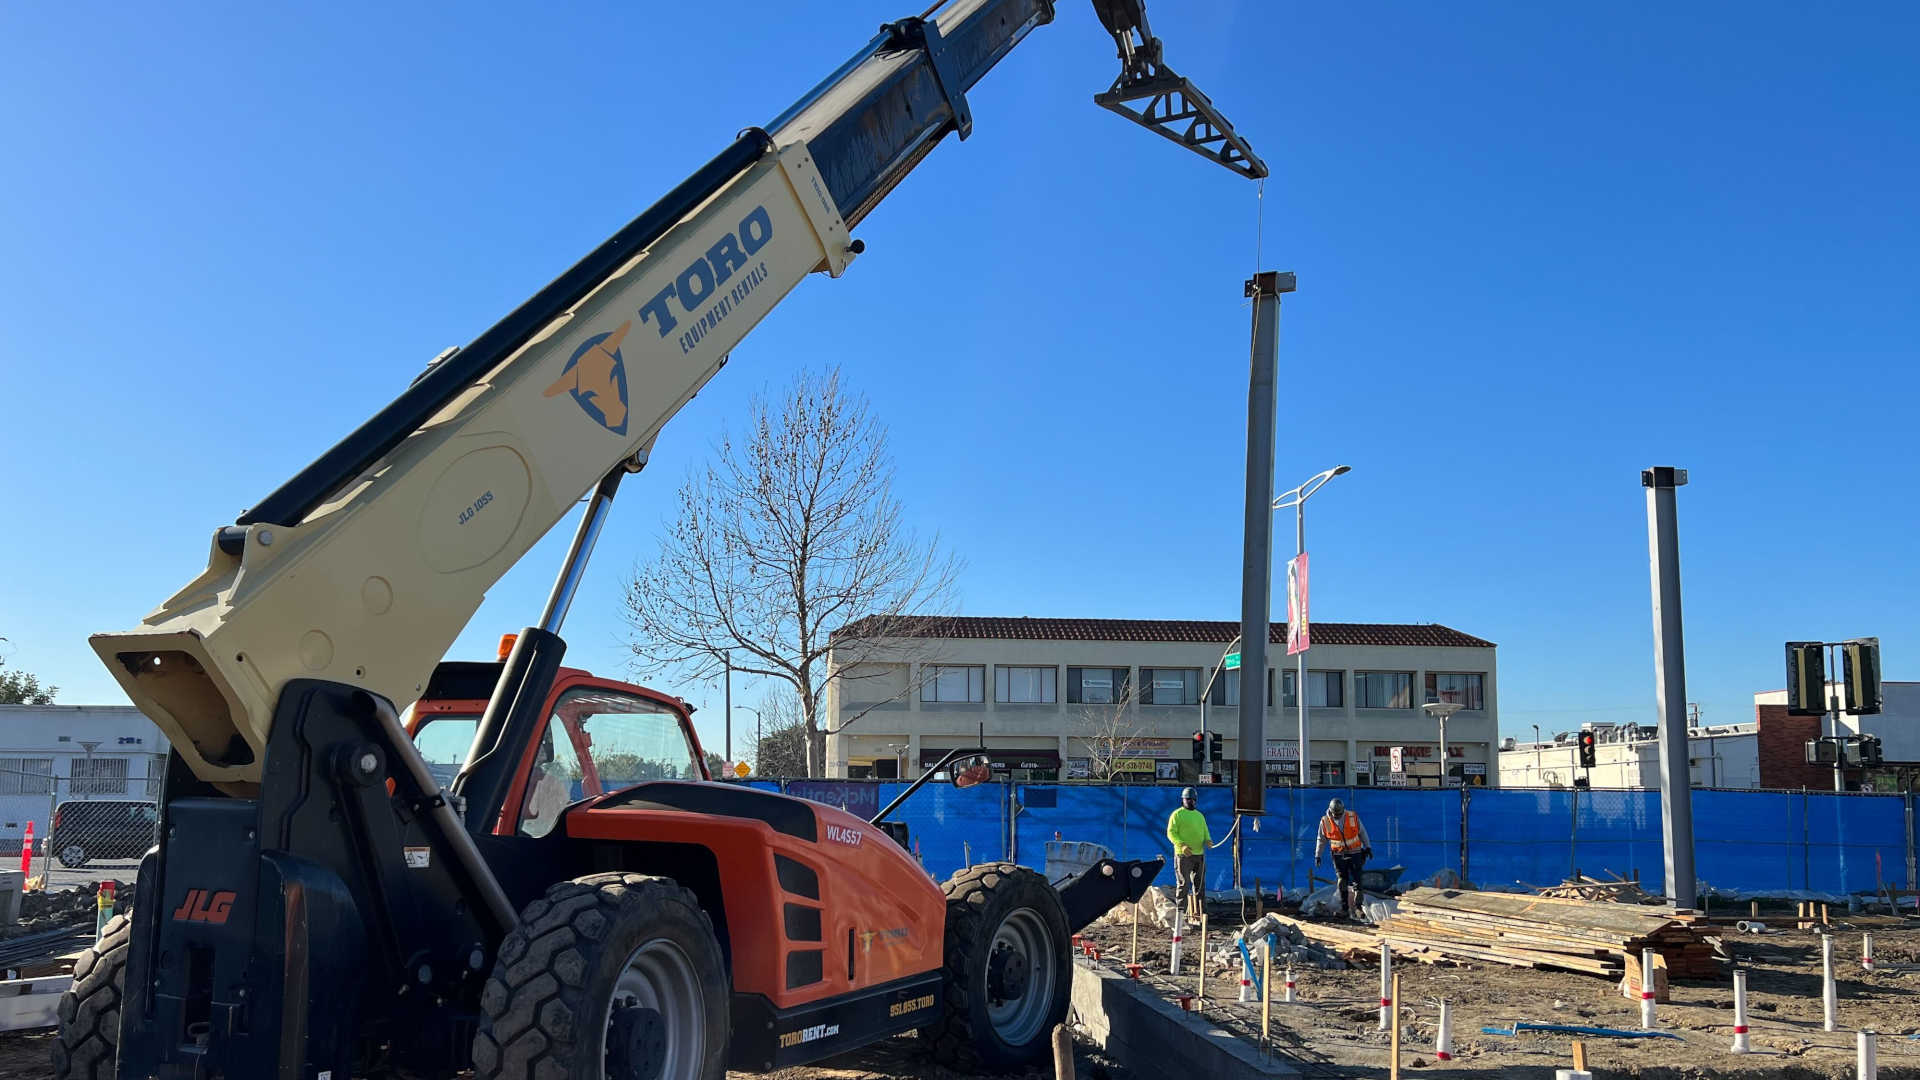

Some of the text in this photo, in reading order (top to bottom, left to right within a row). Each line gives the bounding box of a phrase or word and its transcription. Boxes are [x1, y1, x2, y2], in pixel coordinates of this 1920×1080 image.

[638, 205, 773, 339] TORO
[679, 261, 769, 355] EQUIPMENT RENTALS
[458, 507, 475, 525] JLG
[173, 889, 237, 923] JLG
